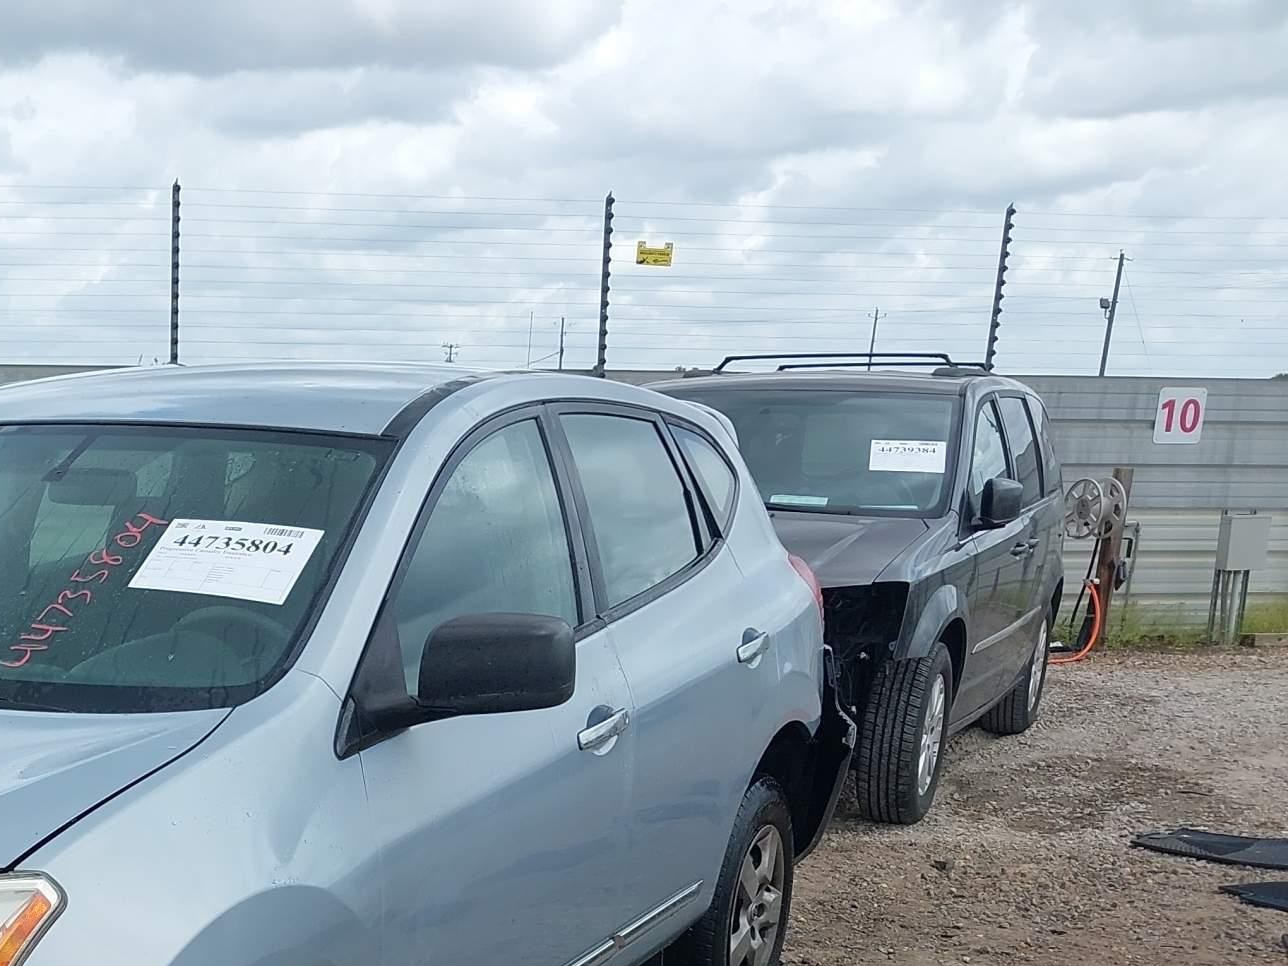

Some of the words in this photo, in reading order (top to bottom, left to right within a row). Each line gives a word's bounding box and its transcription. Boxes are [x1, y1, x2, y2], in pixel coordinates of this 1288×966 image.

[1161, 398, 1201, 433] 10
[878, 446, 936, 454] 44739384
[173, 534, 294, 555] 44735804
[0, 511, 169, 668] 44735804
